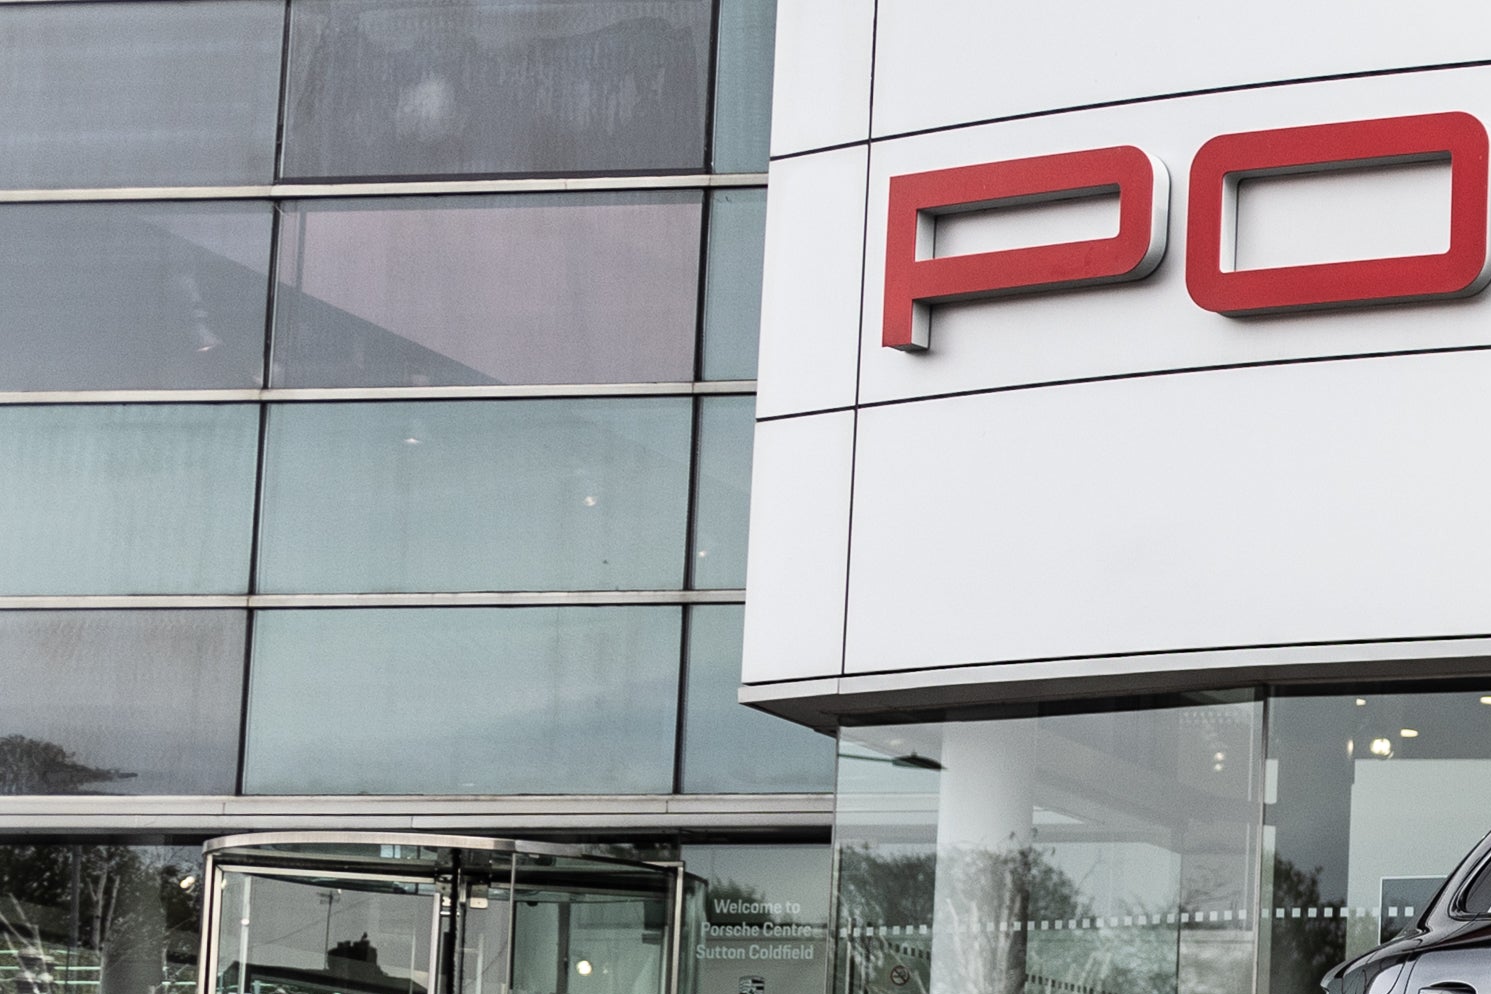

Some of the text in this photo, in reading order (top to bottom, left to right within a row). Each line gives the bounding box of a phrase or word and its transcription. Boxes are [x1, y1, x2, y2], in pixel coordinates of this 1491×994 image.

[714, 899, 801, 915] Welcome to
[701, 921, 813, 937] Porsche Centre
[696, 944, 814, 960] Sutton Coldfield
